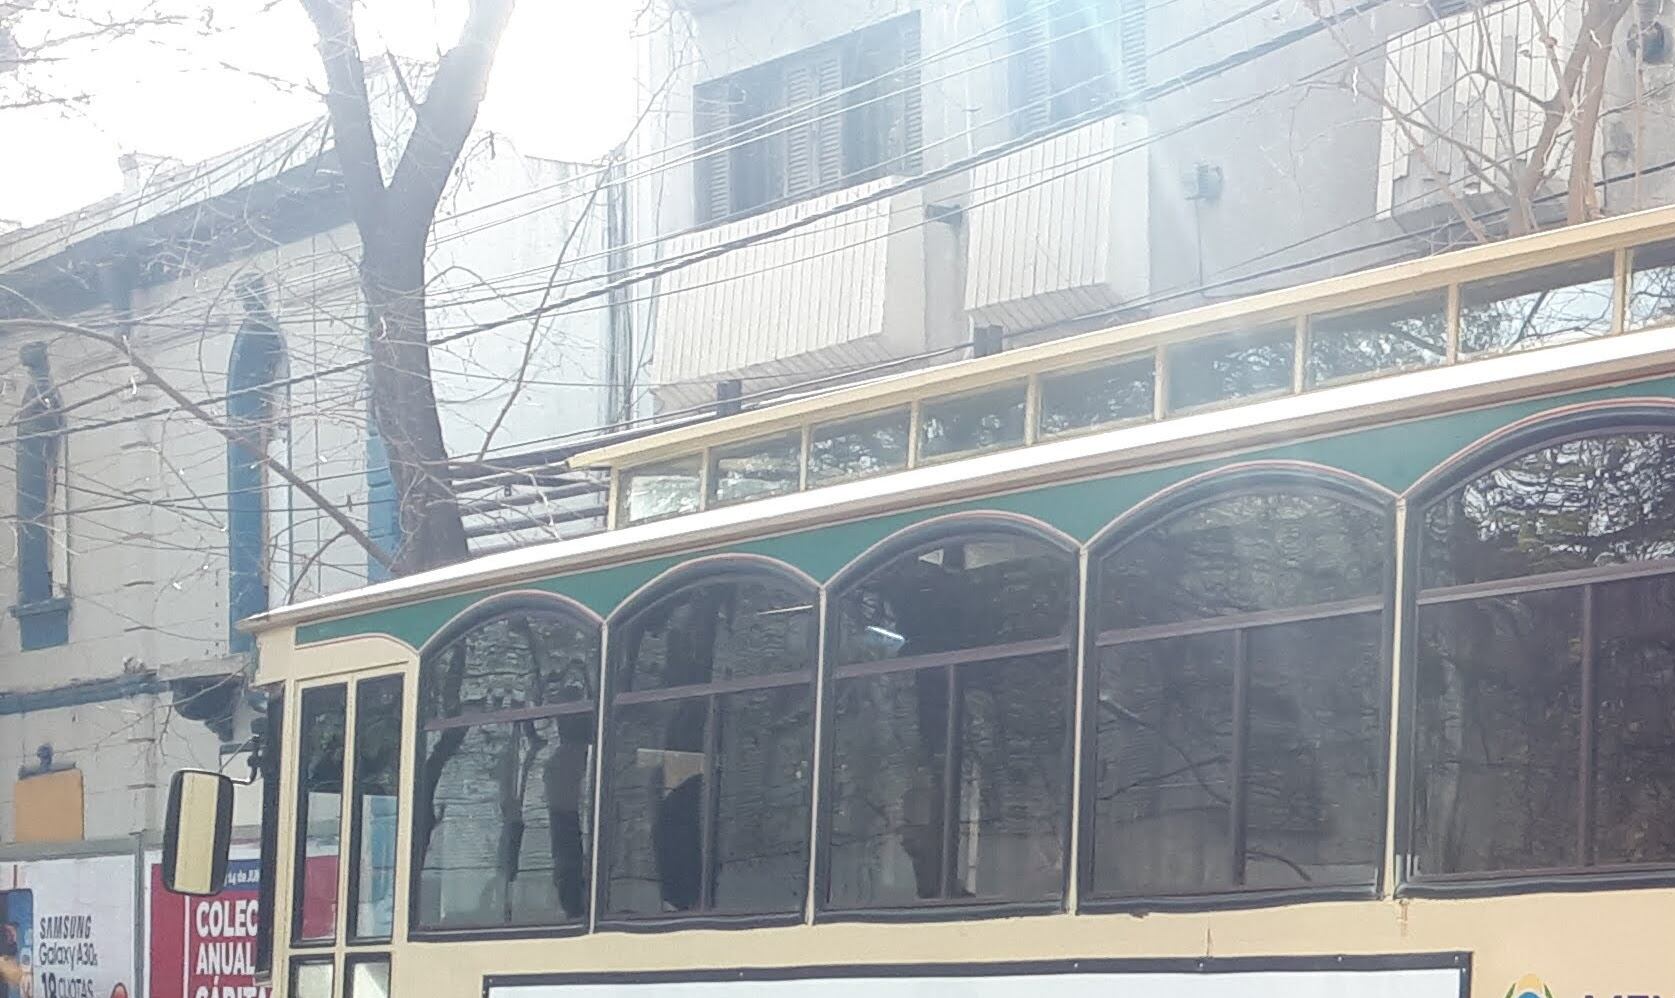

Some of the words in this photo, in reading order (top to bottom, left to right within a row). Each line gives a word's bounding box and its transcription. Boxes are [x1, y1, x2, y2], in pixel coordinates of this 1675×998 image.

[40, 915, 92, 939] SAMSUNG
[39, 942, 76, 971] Galaxy
[196, 942, 255, 976] ANUAL
